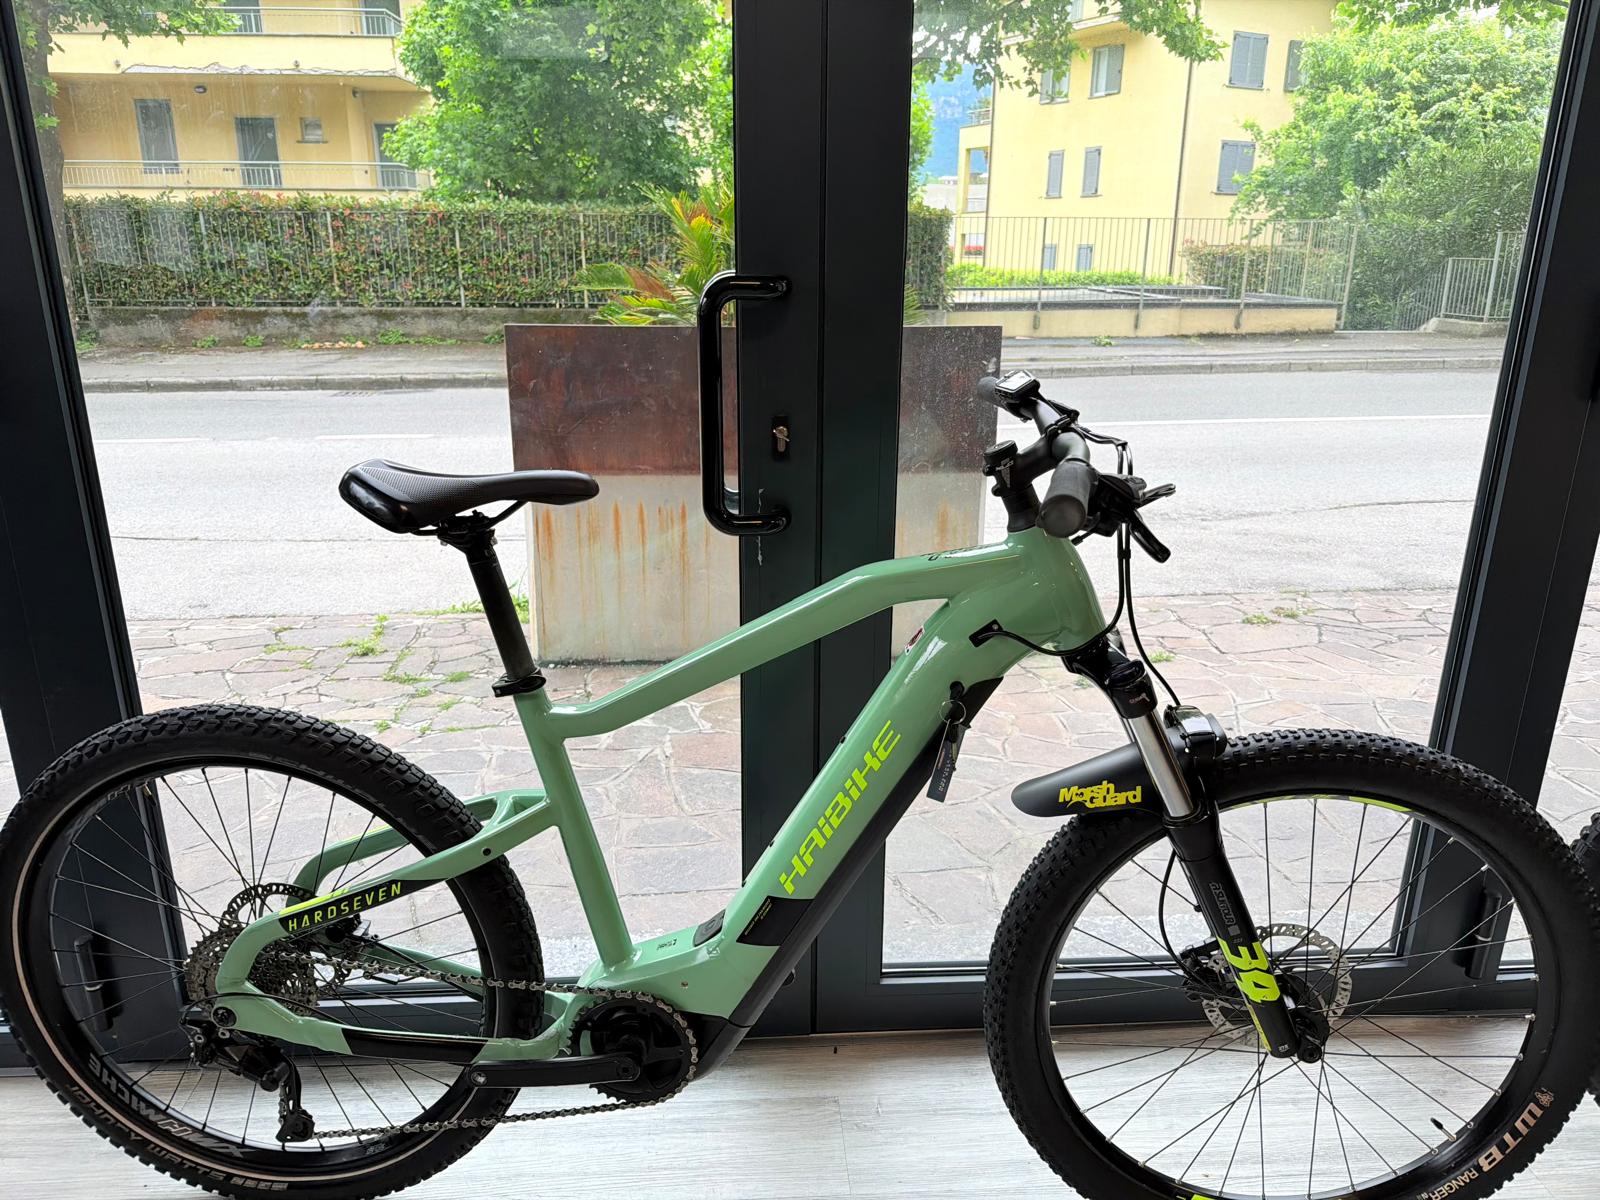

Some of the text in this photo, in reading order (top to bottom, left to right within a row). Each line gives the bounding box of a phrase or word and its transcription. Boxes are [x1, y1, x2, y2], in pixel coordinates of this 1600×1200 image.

[779, 720, 901, 895] HAIBIKE
[1085, 786, 1142, 808] Guard
[288, 881, 401, 931] HARDSEVEN
[151, 1143, 227, 1181] WATTS
[1429, 1102, 1544, 1200] WTB RANGER
